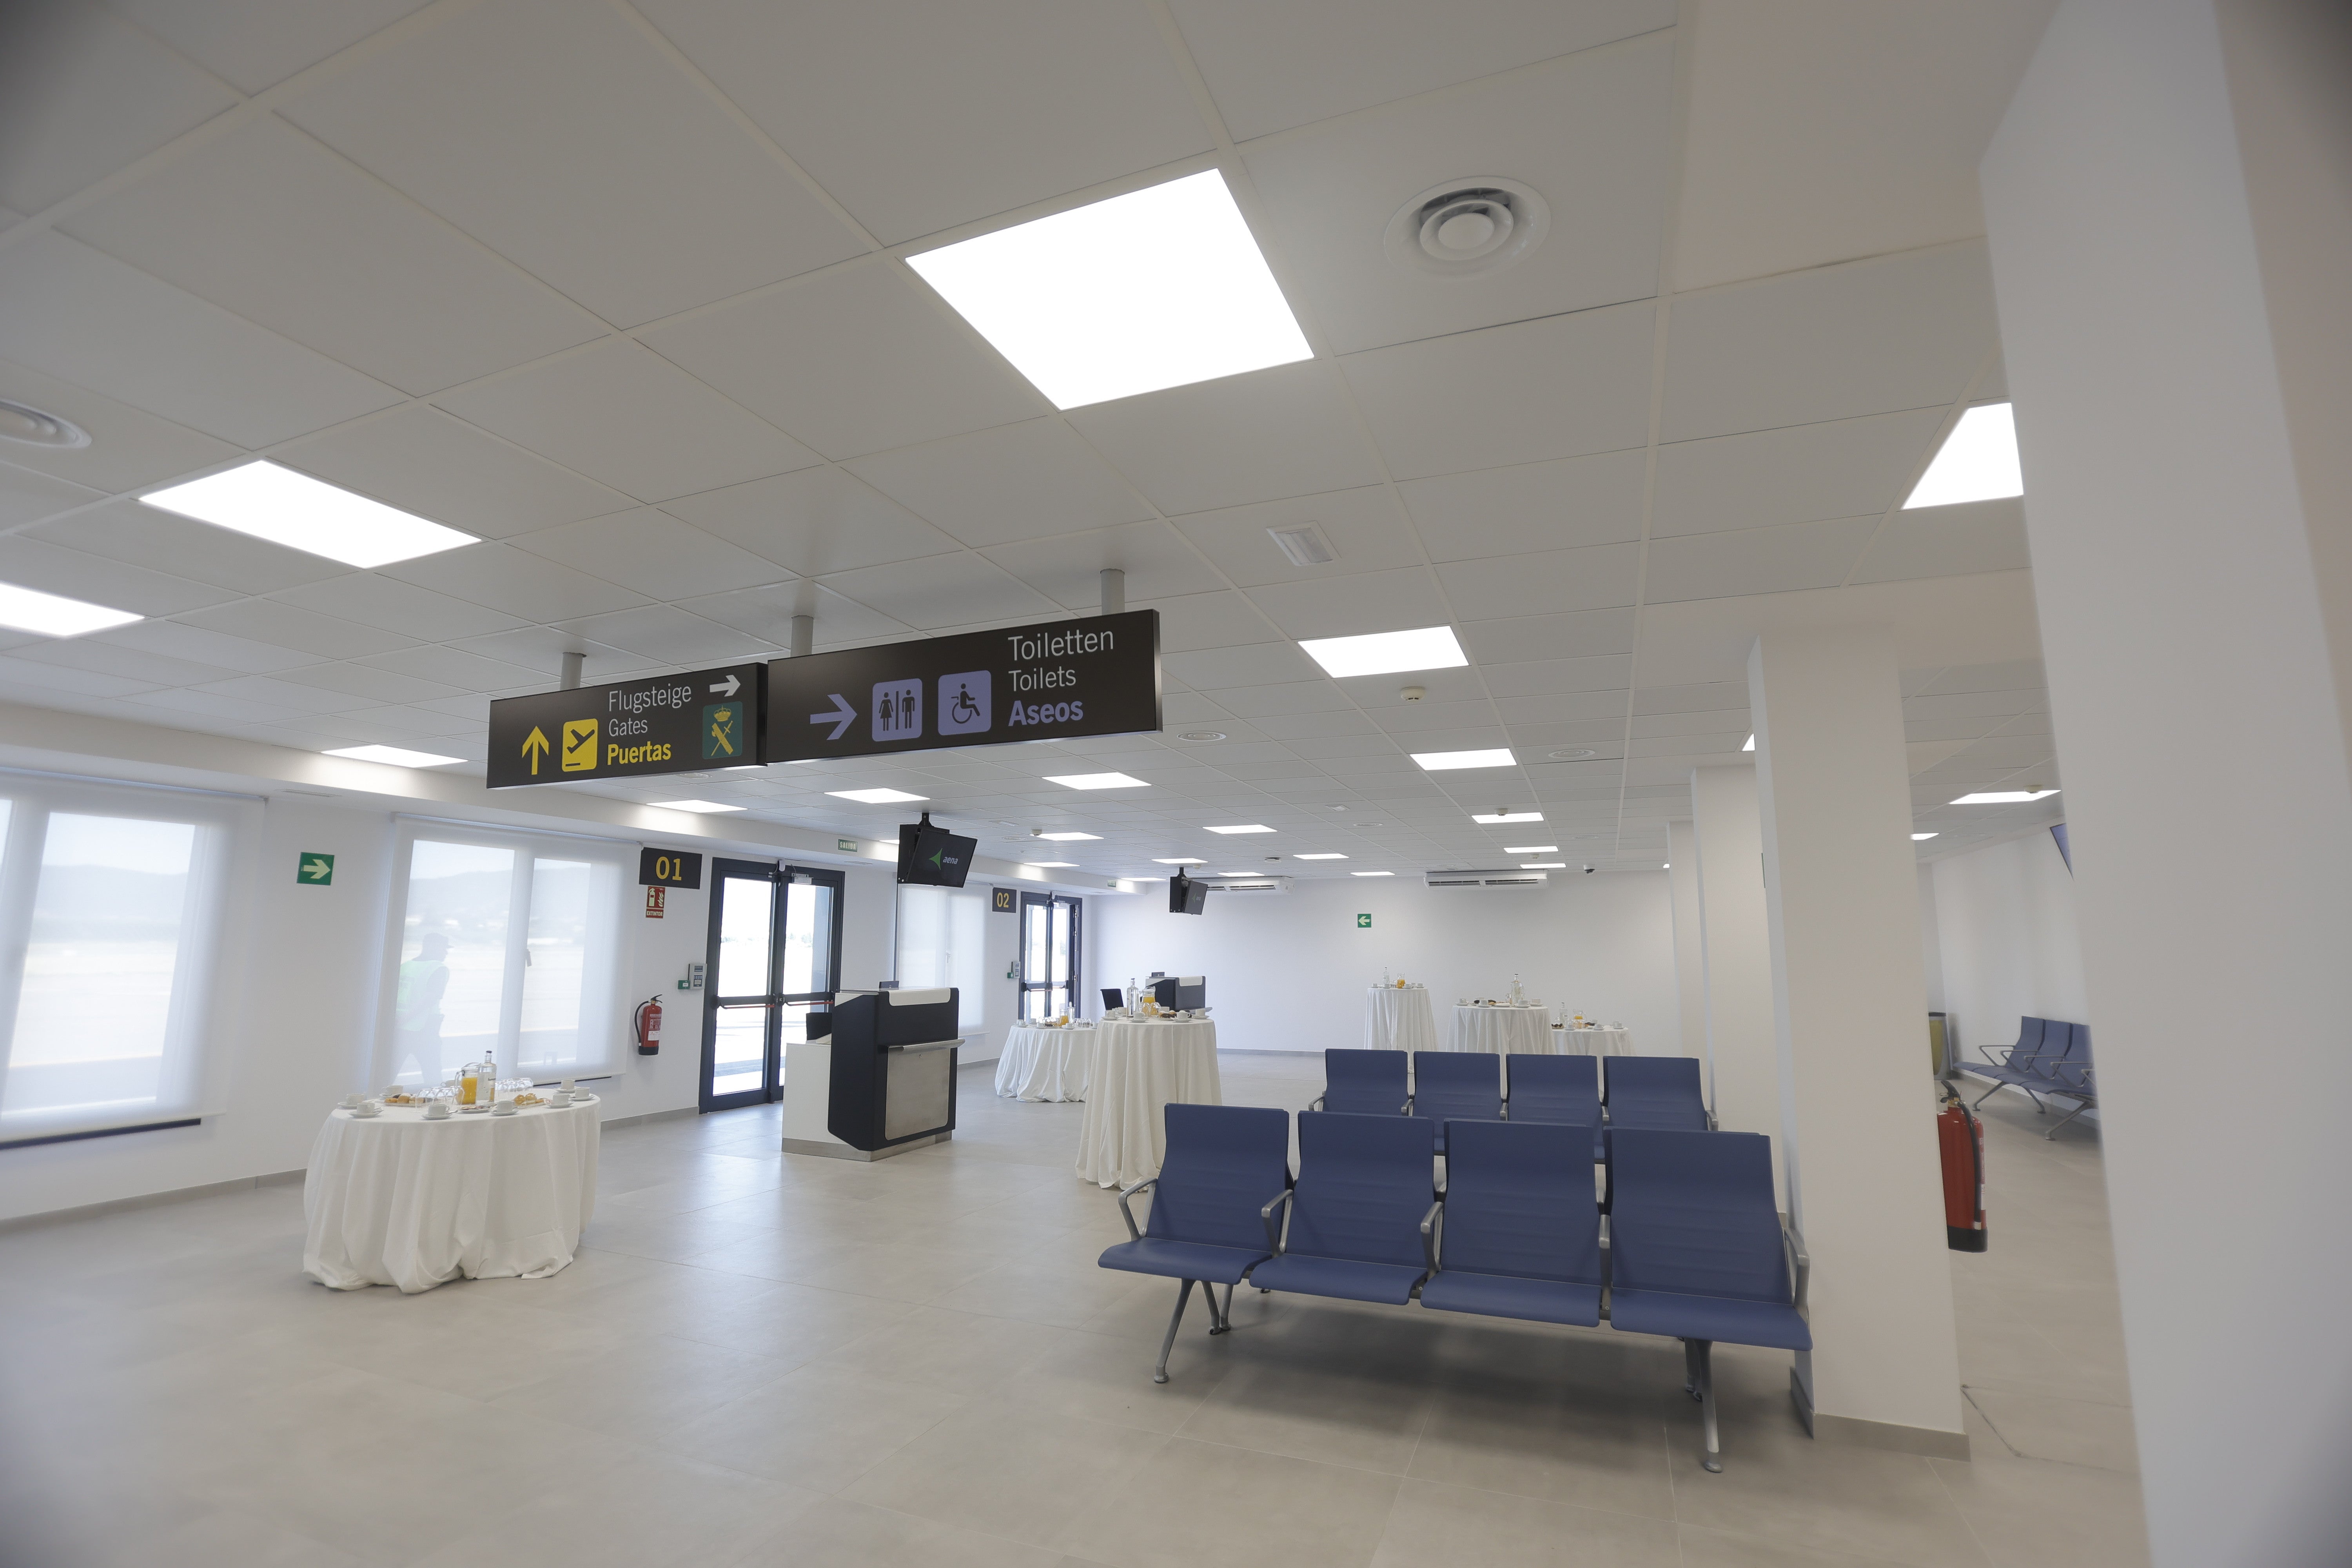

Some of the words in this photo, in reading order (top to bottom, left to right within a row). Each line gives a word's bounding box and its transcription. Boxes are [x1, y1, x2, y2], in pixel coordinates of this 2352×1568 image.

[1007, 629, 1114, 661] Toiletten
[1008, 666, 1076, 691] Toilets
[609, 683, 691, 713] Flugsteige
[1008, 700, 1083, 726] Aseos
[608, 717, 648, 737] Gates
[607, 741, 672, 765] Puertas
[840, 841, 856, 850] SALIDA
[656, 856, 682, 881] 01
[943, 857, 958, 865] aena
[997, 892, 1009, 908] 02
